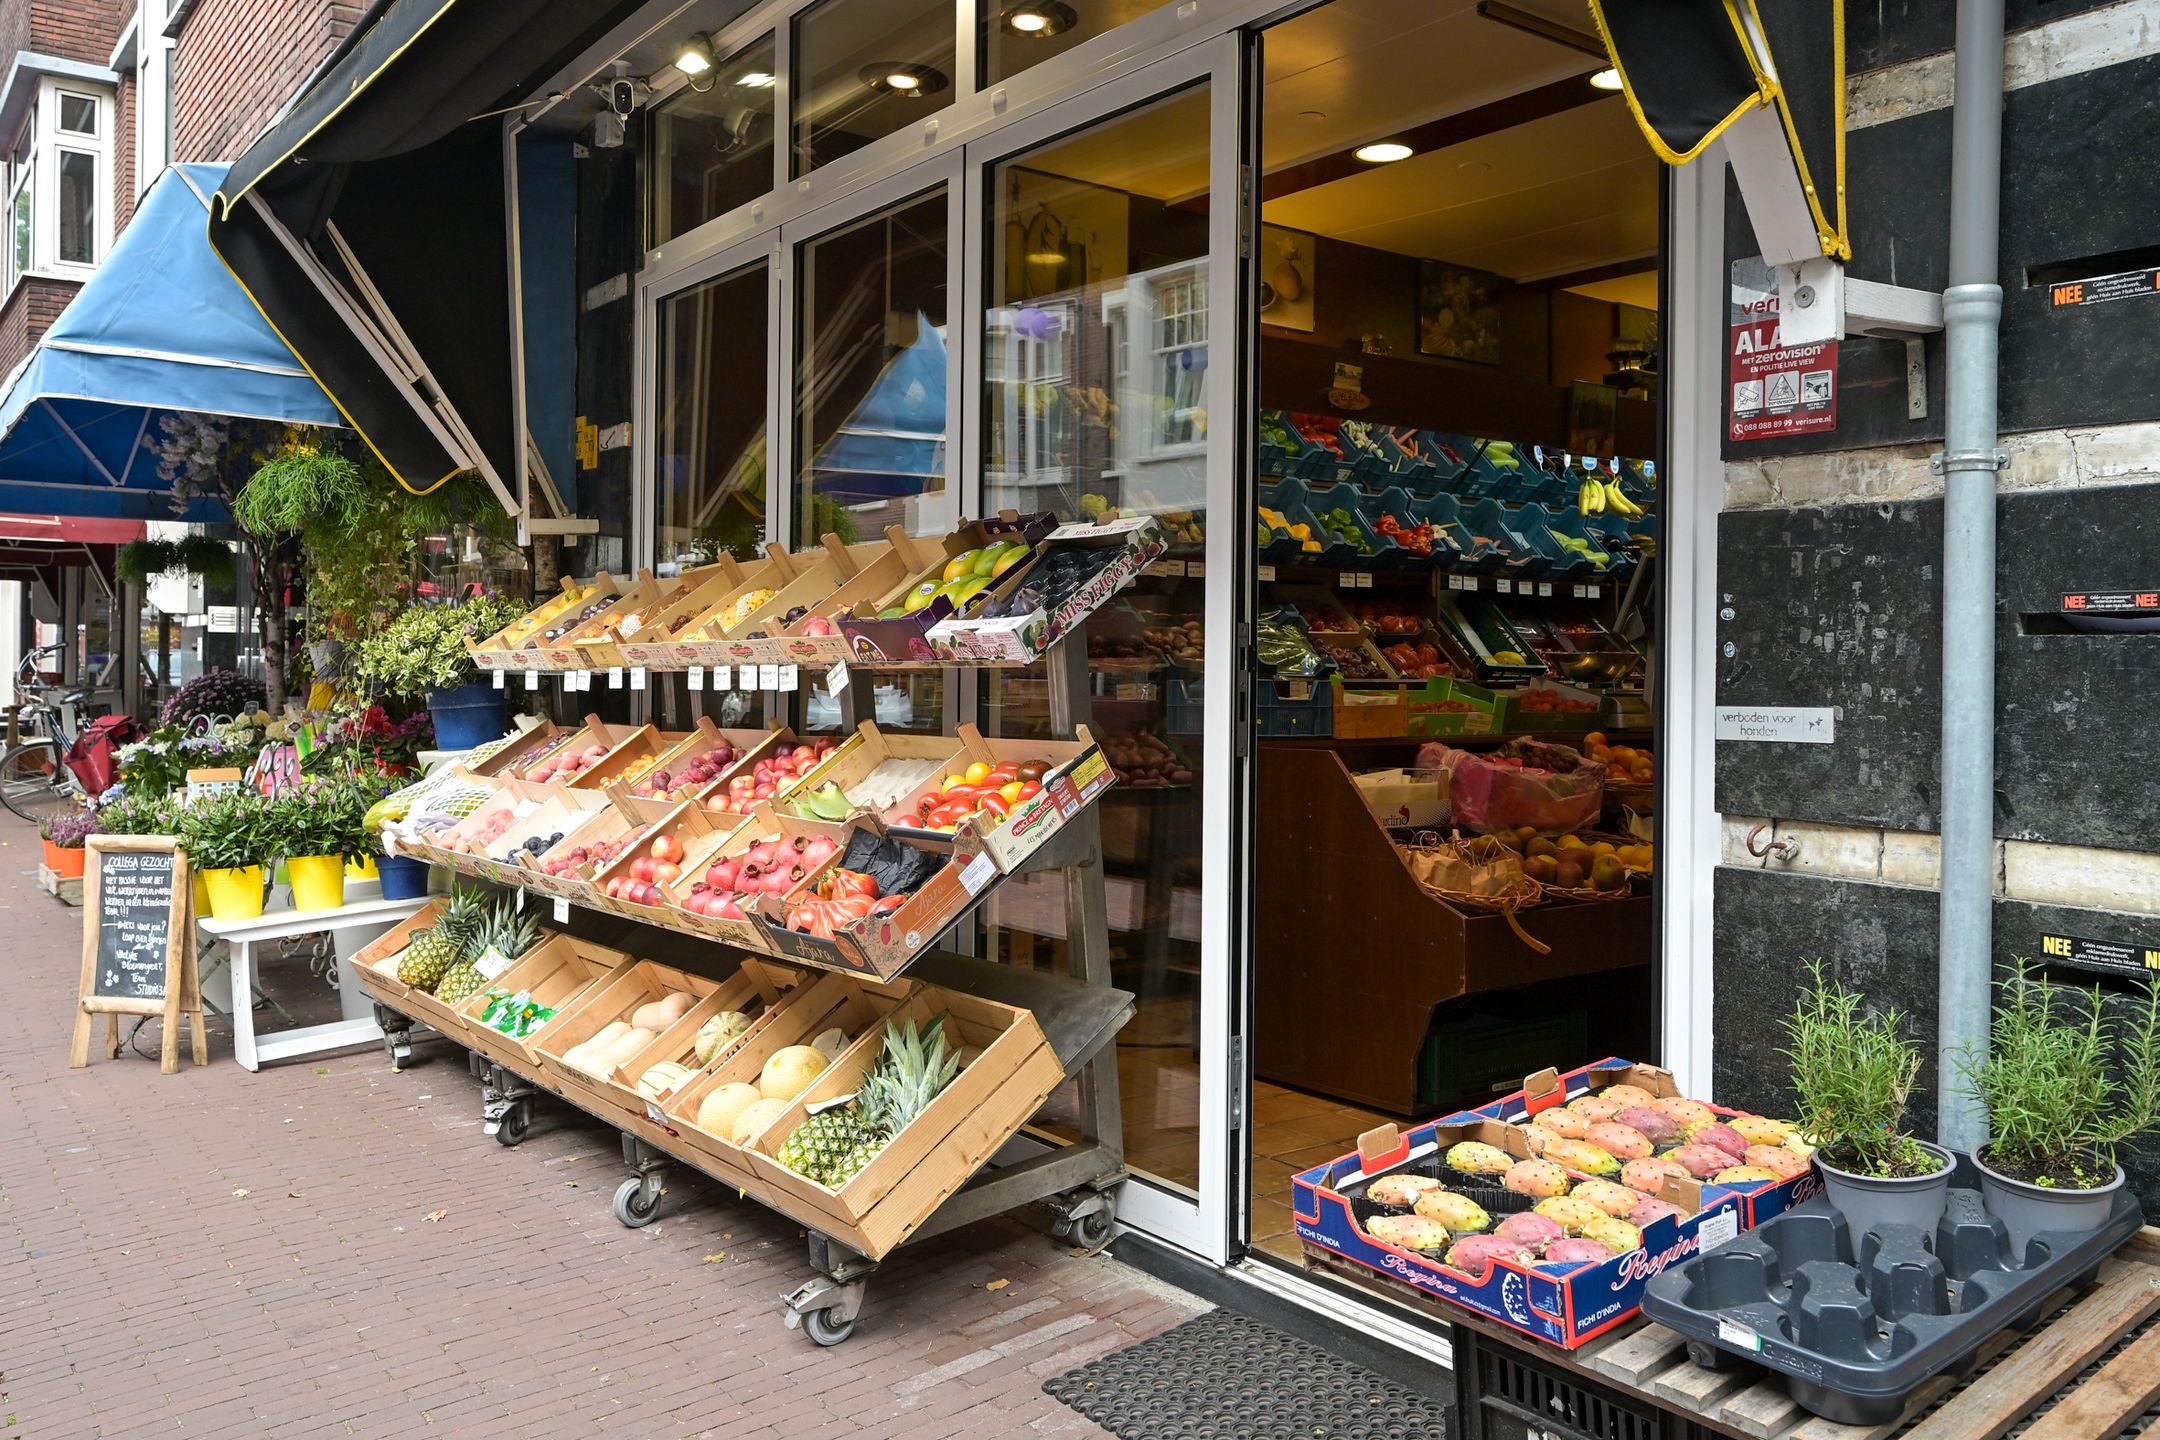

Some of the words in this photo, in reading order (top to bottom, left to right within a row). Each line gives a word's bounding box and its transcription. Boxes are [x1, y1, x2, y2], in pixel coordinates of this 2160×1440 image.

[2054, 285, 2083, 306] NEE
[1741, 357, 1755, 366] MET
[1750, 366, 1759, 374] EN
[1759, 362, 1783, 373] POLITIE
[1784, 360, 1798, 370] LIVE
[1798, 358, 1816, 367] VIEW
[1744, 423, 1757, 432] 088
[1758, 422, 1772, 430] 088
[1773, 420, 1782, 429] 89
[1783, 419, 1793, 427] 99
[1795, 415, 1832, 427] verisure.nl
[1056, 591, 1092, 626] MISS
[1090, 554, 1132, 598] FIGGY
[2064, 595, 2086, 609] NEE
[2135, 593, 2158, 607] NEE
[1722, 712, 1769, 723] verboden
[1771, 714, 1796, 723] voor
[1740, 724, 1778, 736] honden
[1012, 818, 1029, 836] PRINCE
[108, 855, 139, 869] COLLEGA
[140, 856, 174, 868] GEZOCHT
[139, 875, 153, 884] VOOR
[2043, 935, 2072, 957] NEE
[1298, 1227, 1317, 1239] FICHI
[1316, 1233, 1341, 1249] D'INDIA
[1380, 1253, 1457, 1296] Regina
[1577, 1313, 1597, 1330] FICHI
[1596, 1301, 1622, 1320] D'INDIA
